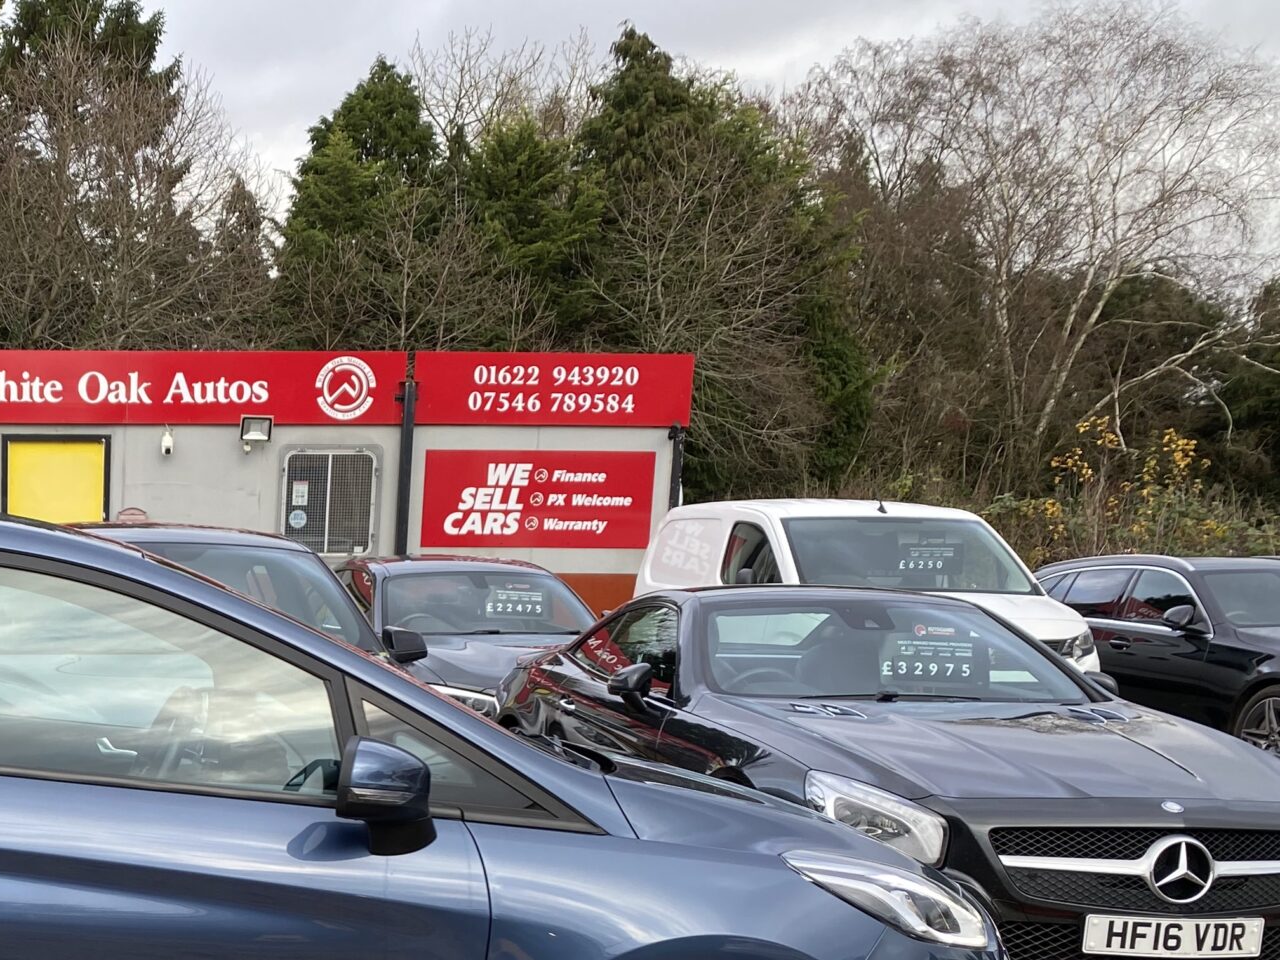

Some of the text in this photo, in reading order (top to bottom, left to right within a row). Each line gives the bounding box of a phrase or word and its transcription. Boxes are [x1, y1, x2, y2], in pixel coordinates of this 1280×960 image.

[473, 365, 639, 386] 01622 943920
[78, 370, 153, 405] Oak
[163, 371, 269, 404] Autos
[468, 391, 635, 414] 07546 789584
[487, 463, 534, 487] WE
[551, 469, 607, 483] Finance
[457, 487, 524, 511] SELL
[546, 493, 632, 507] PX Welcome
[443, 511, 521, 536] CARS
[543, 517, 608, 533] Warranty
[899, 560, 943, 569] £6250
[486, 603, 542, 613] £22475
[881, 661, 971, 677] £32975
[1106, 920, 1246, 952] HF16 VDR
